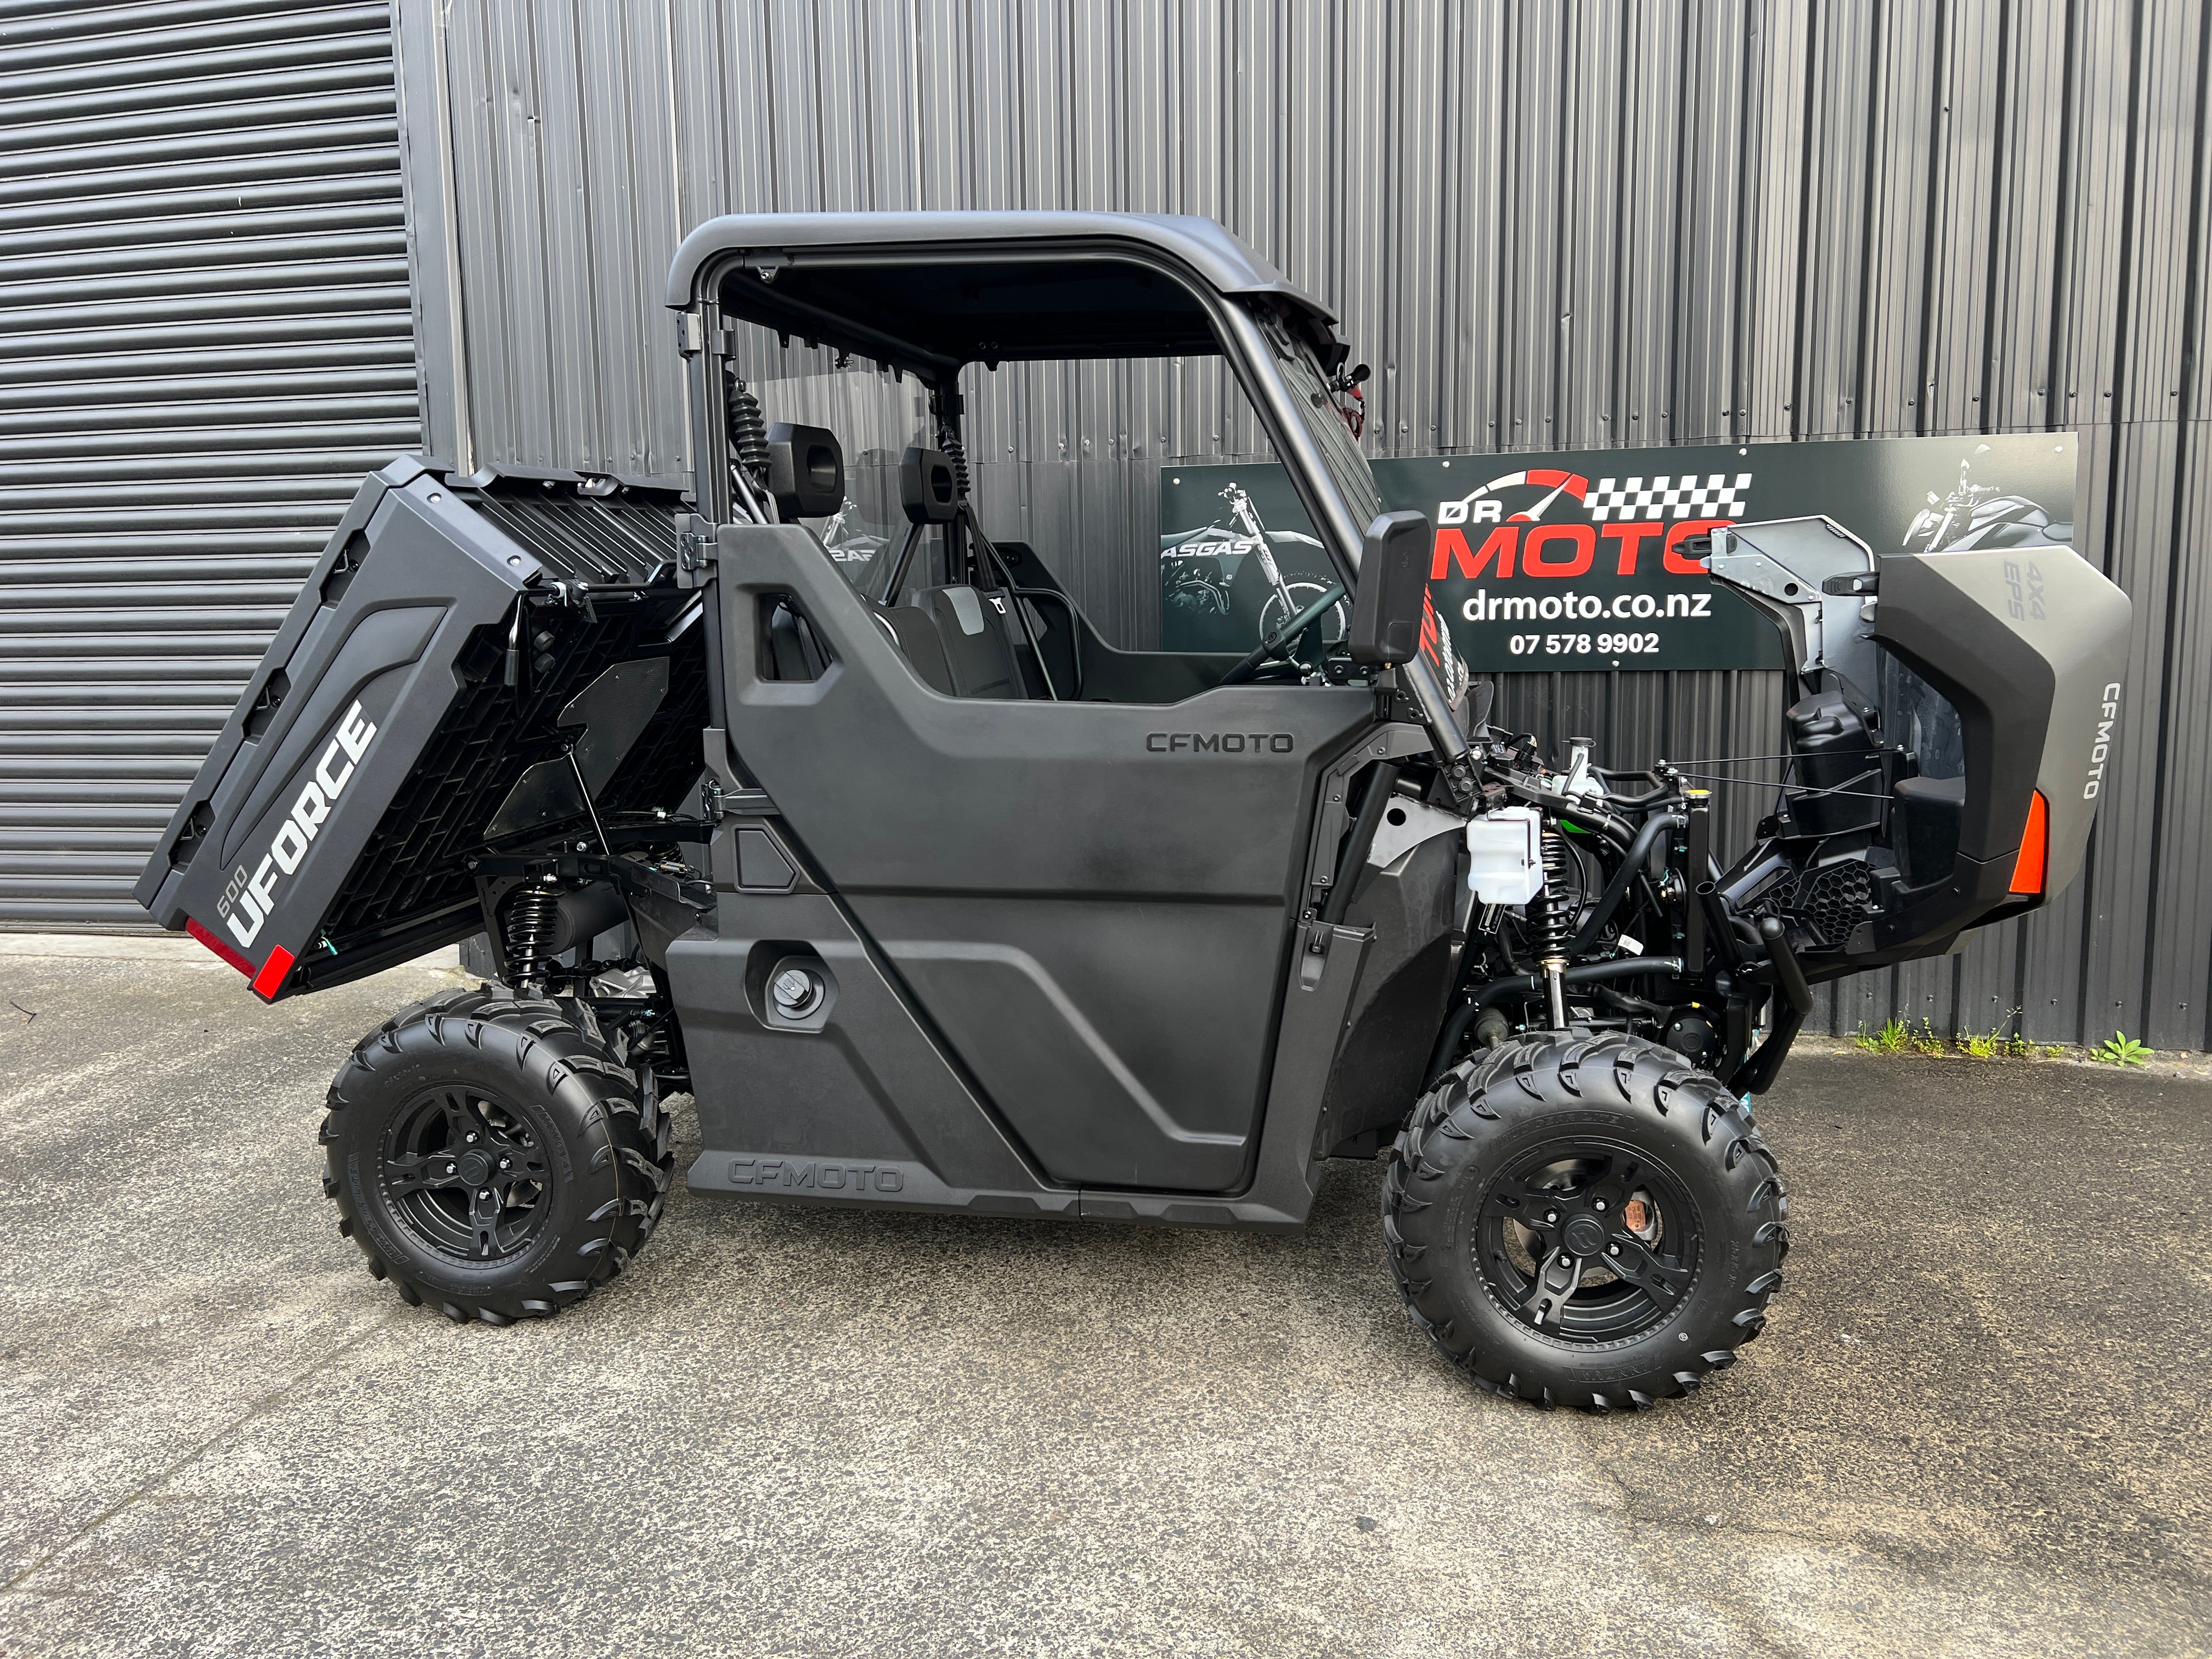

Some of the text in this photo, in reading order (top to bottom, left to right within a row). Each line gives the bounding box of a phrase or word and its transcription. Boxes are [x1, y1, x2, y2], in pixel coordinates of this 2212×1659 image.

[1437, 500, 1503, 524] DR
[1430, 520, 1737, 579] MOTO
[1463, 589, 1712, 620] drmoto.co.nz
[2004, 560, 2025, 622] EPS
[2027, 561, 2046, 620] 4X4
[1510, 633, 1660, 654] 07 578 9902
[1146, 732, 1294, 753] CFMOTO
[2083, 682, 2120, 799] CFMOTO
[227, 699, 377, 948] UFORCE
[217, 865, 249, 919] 600
[727, 1158, 904, 1192] CFMOTO
